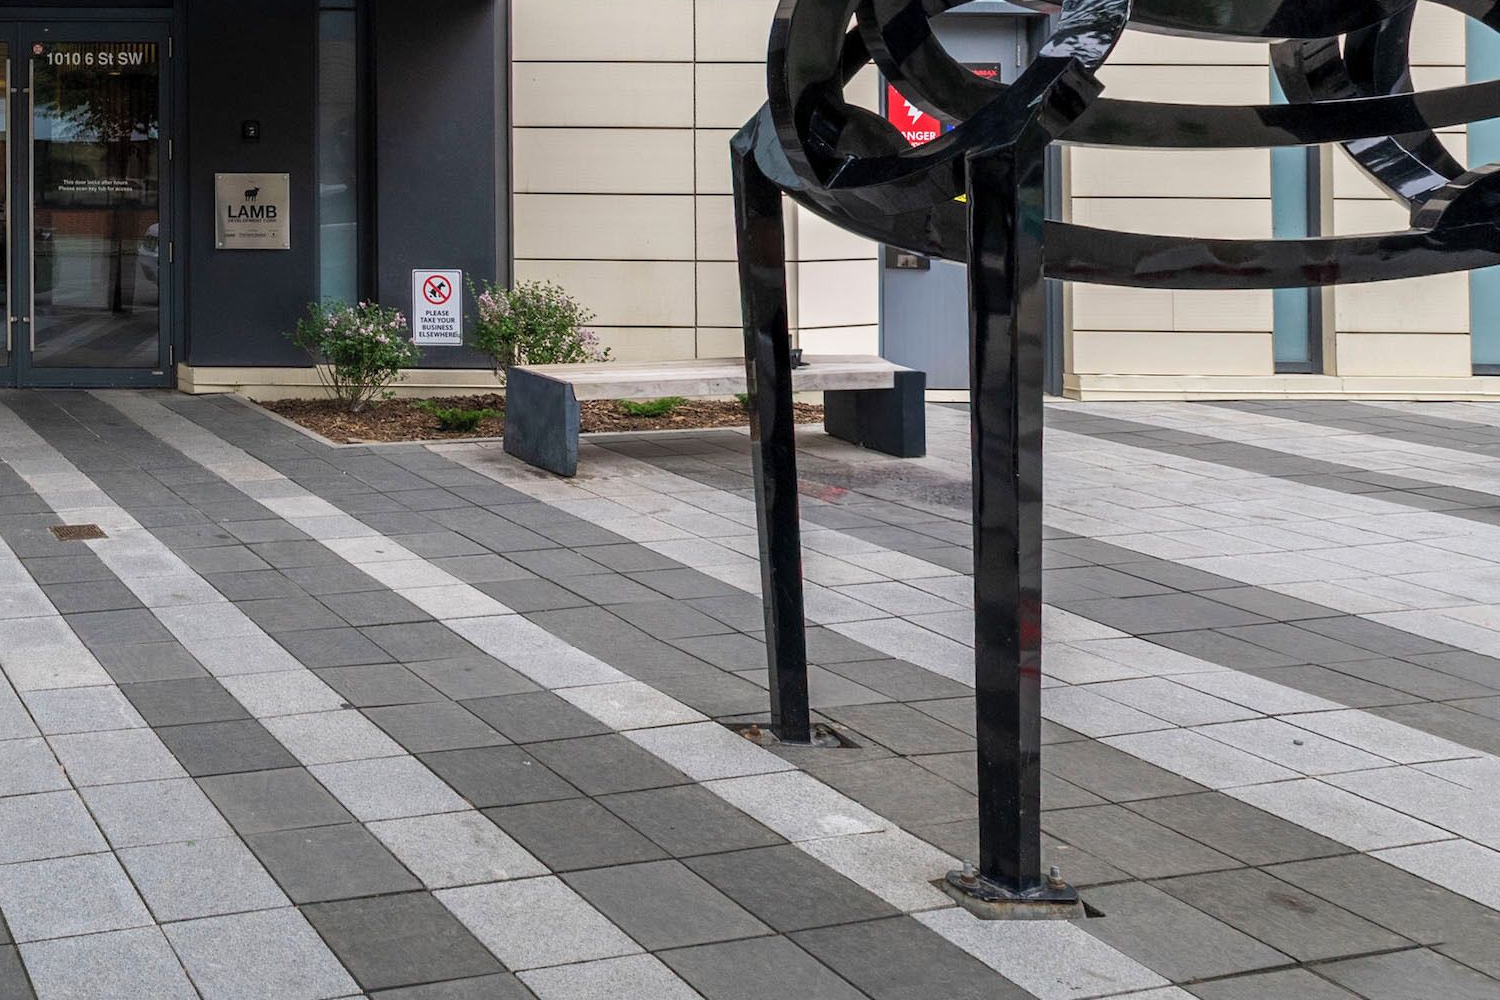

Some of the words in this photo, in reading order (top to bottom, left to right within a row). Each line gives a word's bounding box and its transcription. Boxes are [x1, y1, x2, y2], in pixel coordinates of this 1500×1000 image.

[46, 52, 81, 66] 1010
[84, 52, 94, 66] 6
[98, 52, 114, 66] St
[117, 52, 143, 66] SW
[901, 131, 937, 141] NGER
[227, 205, 277, 219] LAMB
